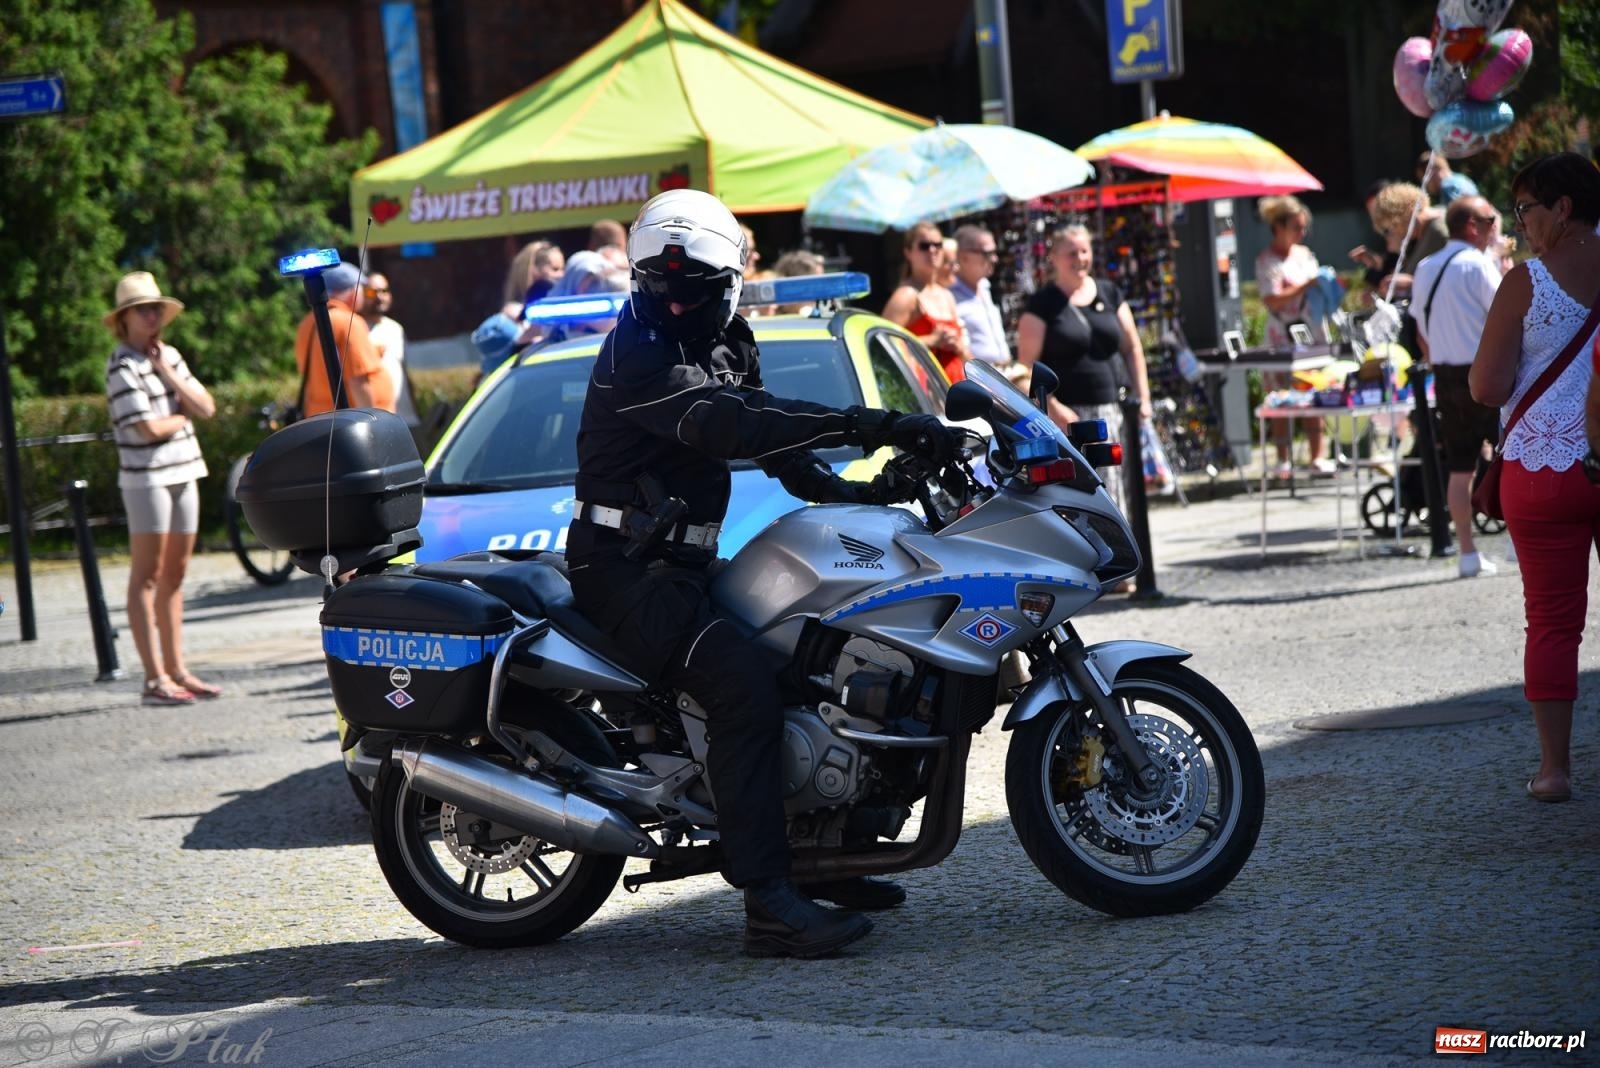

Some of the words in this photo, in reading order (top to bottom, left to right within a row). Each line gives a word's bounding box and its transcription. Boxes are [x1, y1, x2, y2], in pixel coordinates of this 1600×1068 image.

[408, 180, 501, 223] ŚWIEŻE
[508, 174, 650, 213] TRUSKAWKI
[833, 561, 884, 570] HONDA
[983, 625, 994, 636] R
[357, 636, 445, 663] POLICJA
